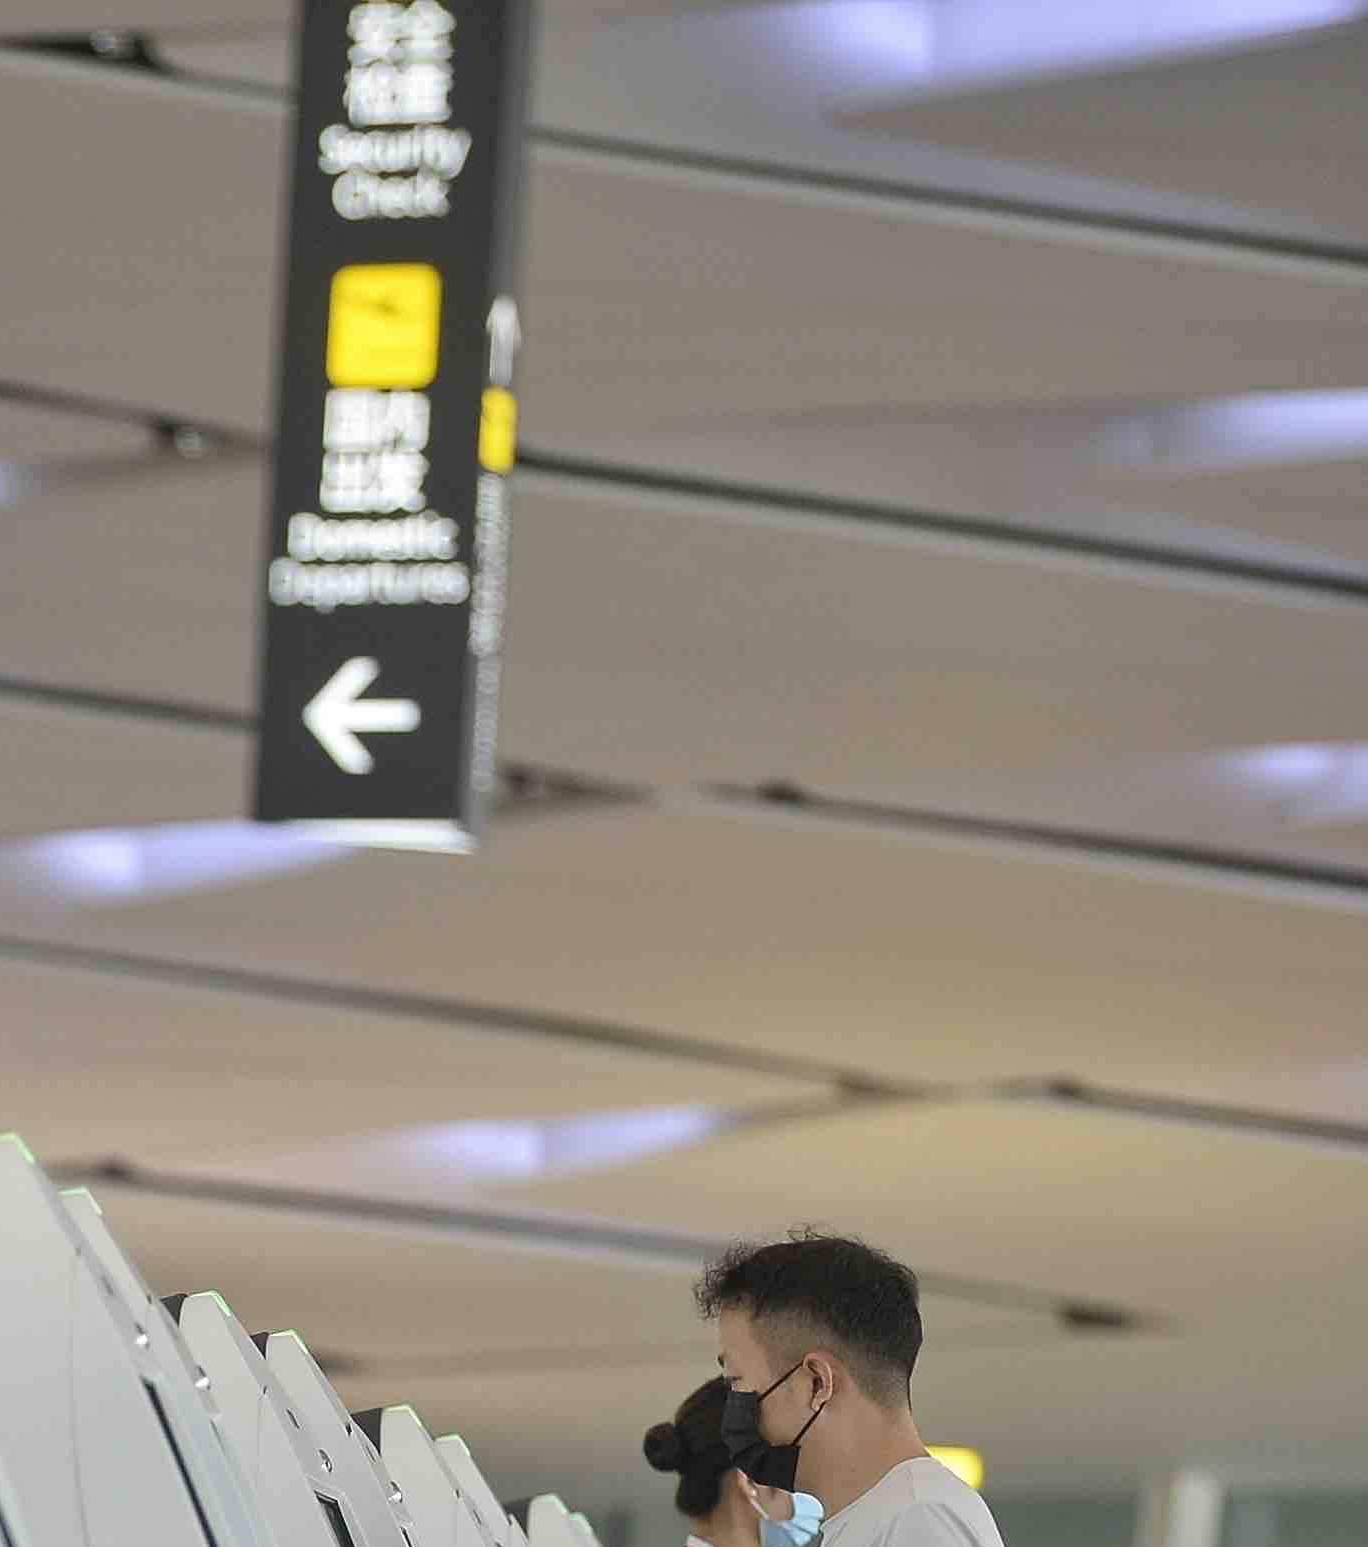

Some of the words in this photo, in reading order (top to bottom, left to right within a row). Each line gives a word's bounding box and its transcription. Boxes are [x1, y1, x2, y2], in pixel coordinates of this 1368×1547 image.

[319, 124, 471, 180] Security
[332, 169, 451, 220] Check
[288, 510, 459, 561] Domestic
[269, 557, 470, 613] Departures
